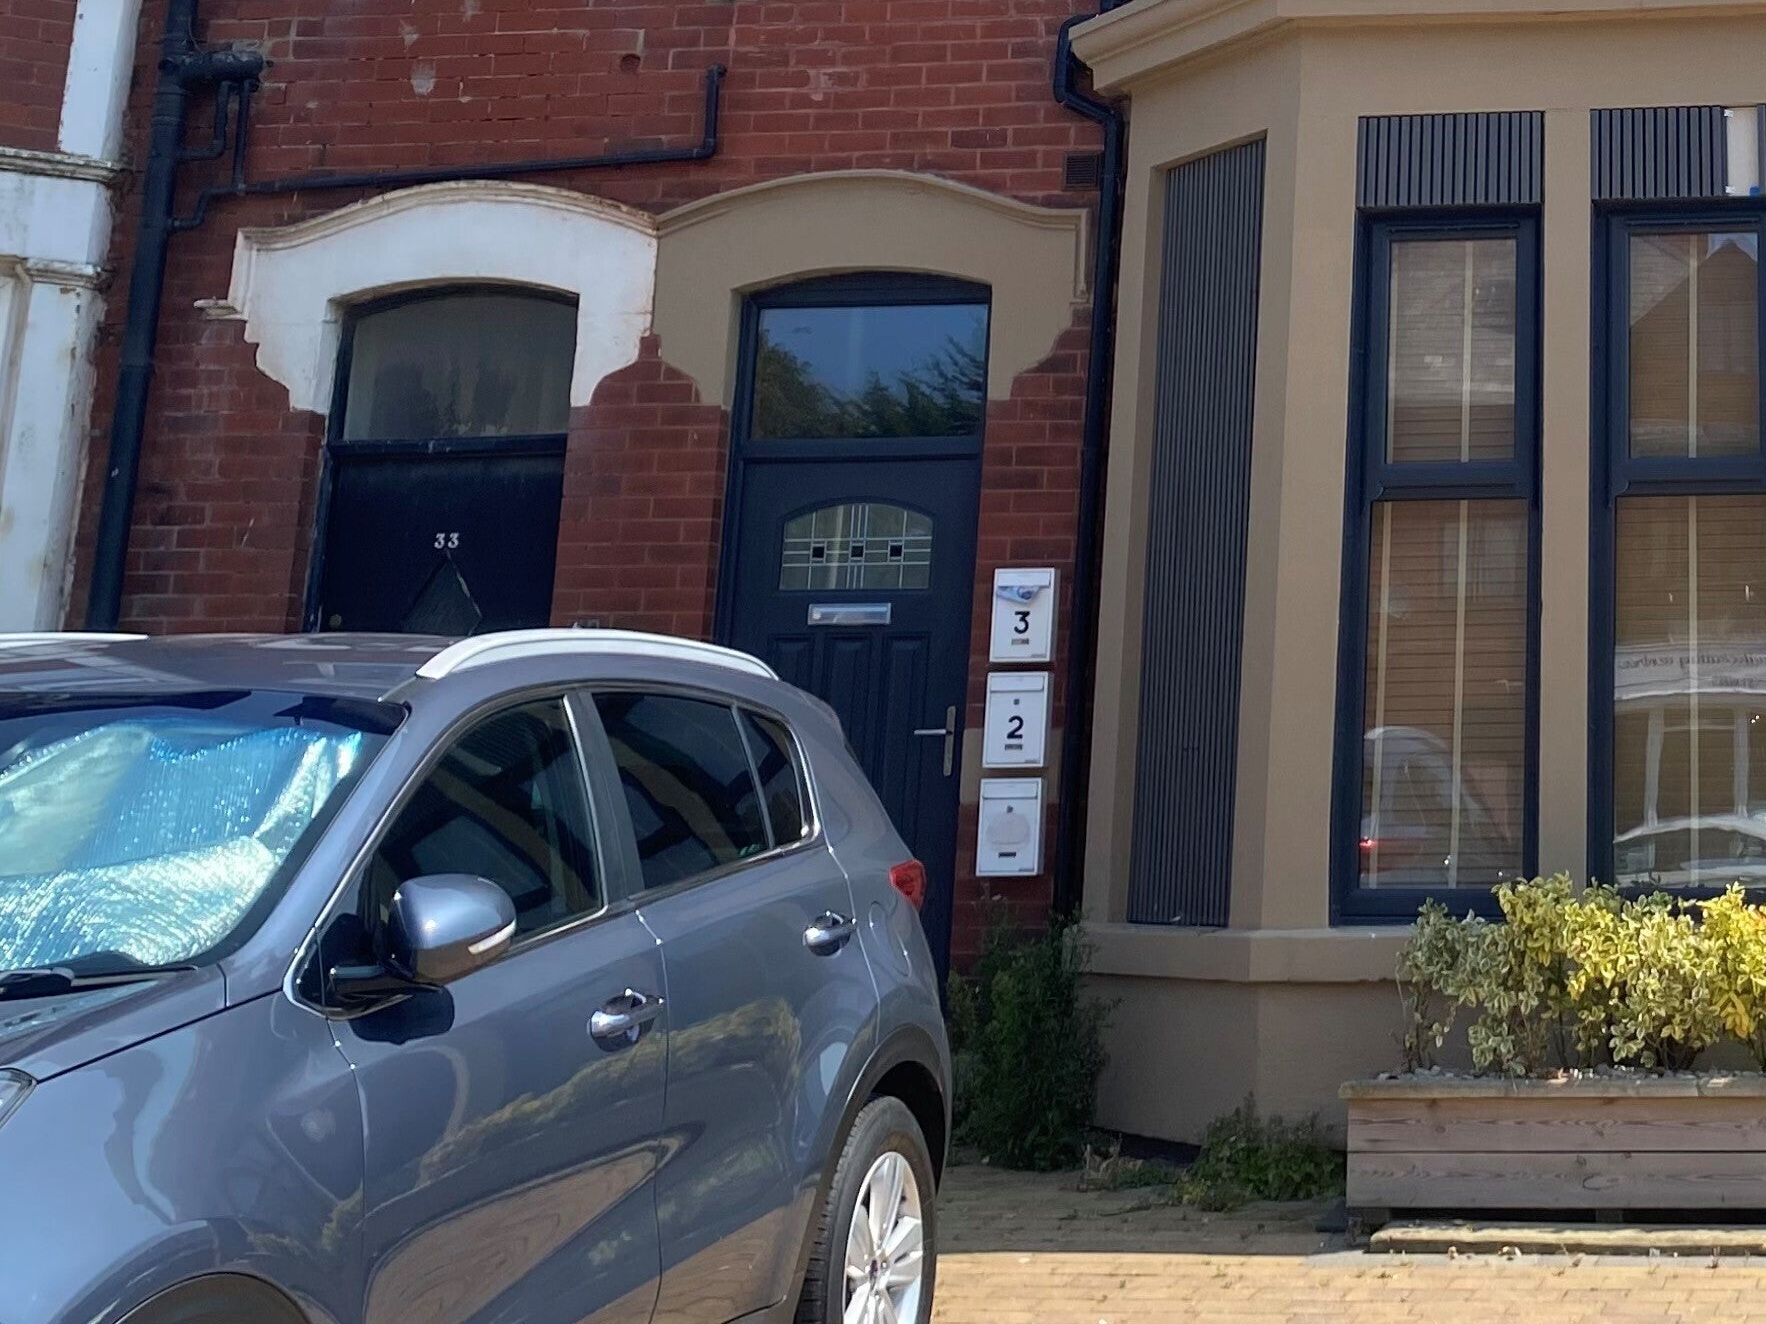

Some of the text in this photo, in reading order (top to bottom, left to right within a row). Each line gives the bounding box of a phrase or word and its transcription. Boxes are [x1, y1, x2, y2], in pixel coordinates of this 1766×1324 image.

[434, 532, 459, 549] 33
[1013, 610, 1031, 634] 3
[1006, 715, 1024, 739] 2
